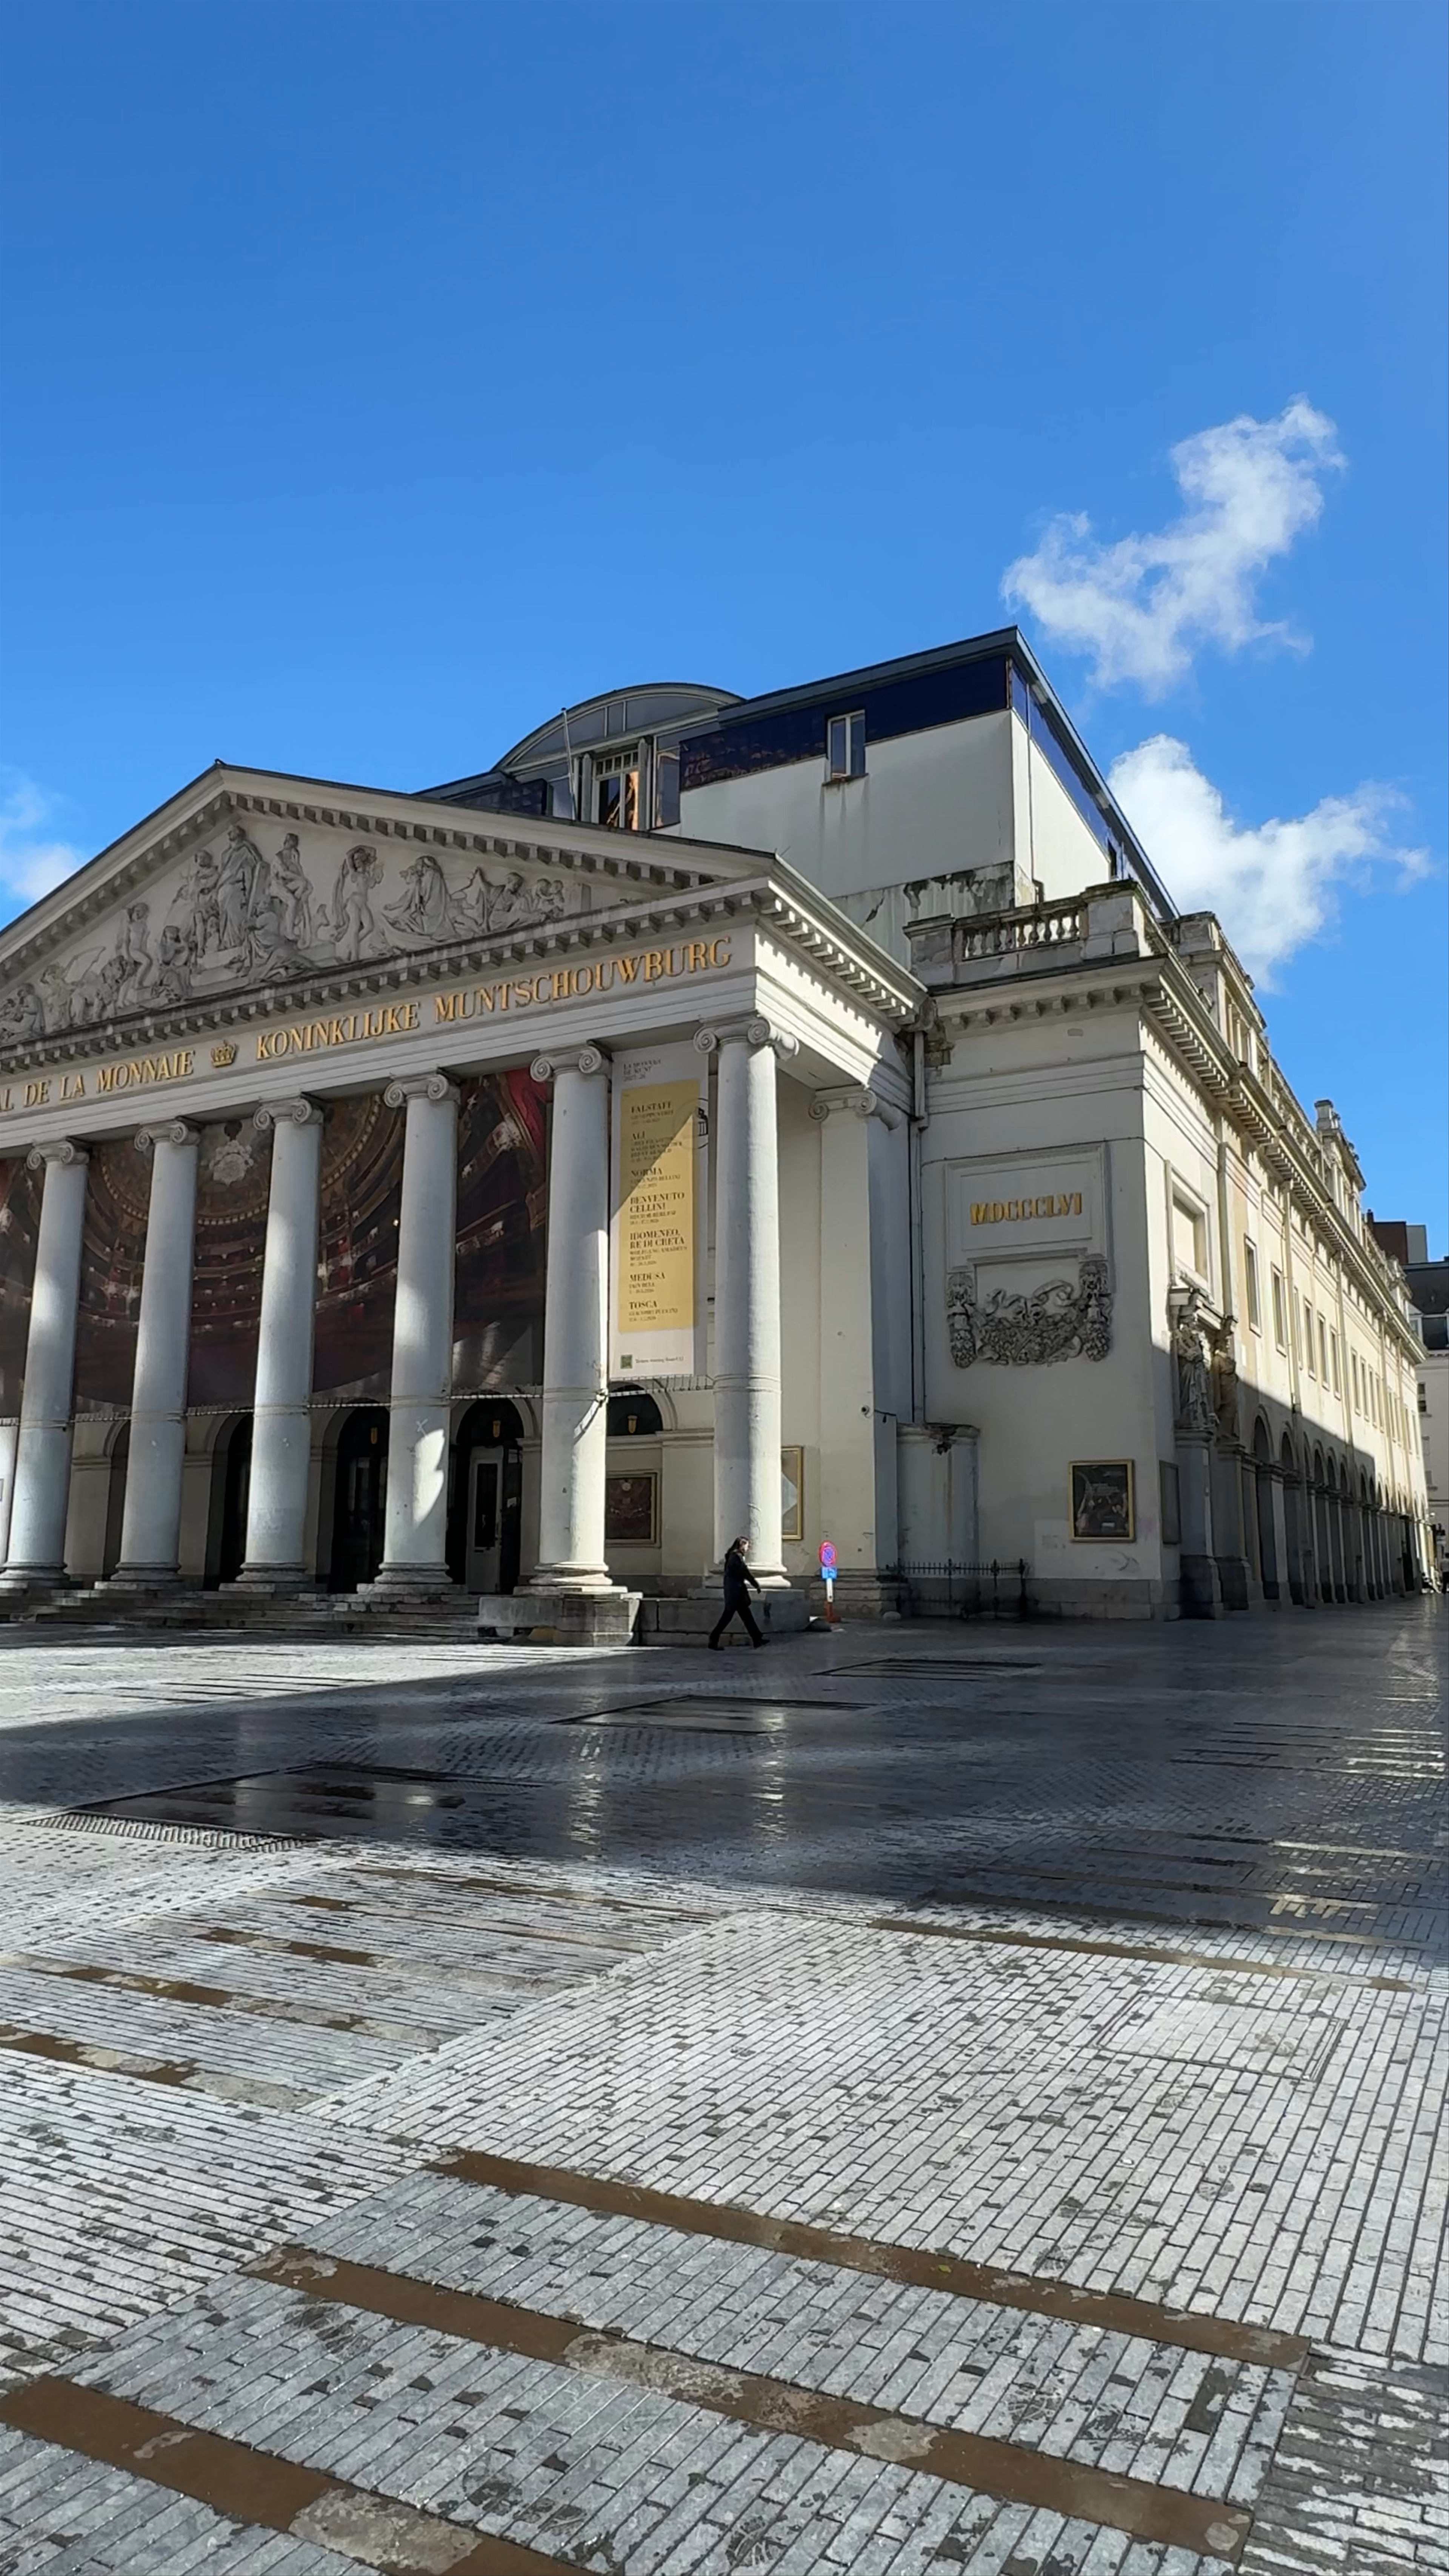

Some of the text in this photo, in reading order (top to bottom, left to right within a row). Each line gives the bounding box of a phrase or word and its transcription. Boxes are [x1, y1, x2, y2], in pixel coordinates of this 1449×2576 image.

[257, 936, 731, 1062] KONINKLIJKE MUNTSCHOUWBURG
[0, 1050, 195, 1112] L DE LA MONNAIE
[631, 1101, 671, 1113] FALSTAFF
[631, 1167, 662, 1177] NORMA
[630, 1192, 685, 1204] BENVENUTO
[630, 1203, 665, 1213] CELLINI
[970, 1192, 1082, 1226] MDCCCLVI
[630, 1229, 680, 1240] IDOMENEO,
[630, 1241, 642, 1249] RE
[655, 1237, 685, 1246] CRETA
[630, 1272, 665, 1281] MEDUSA
[629, 1301, 657, 1309] TOSCA
